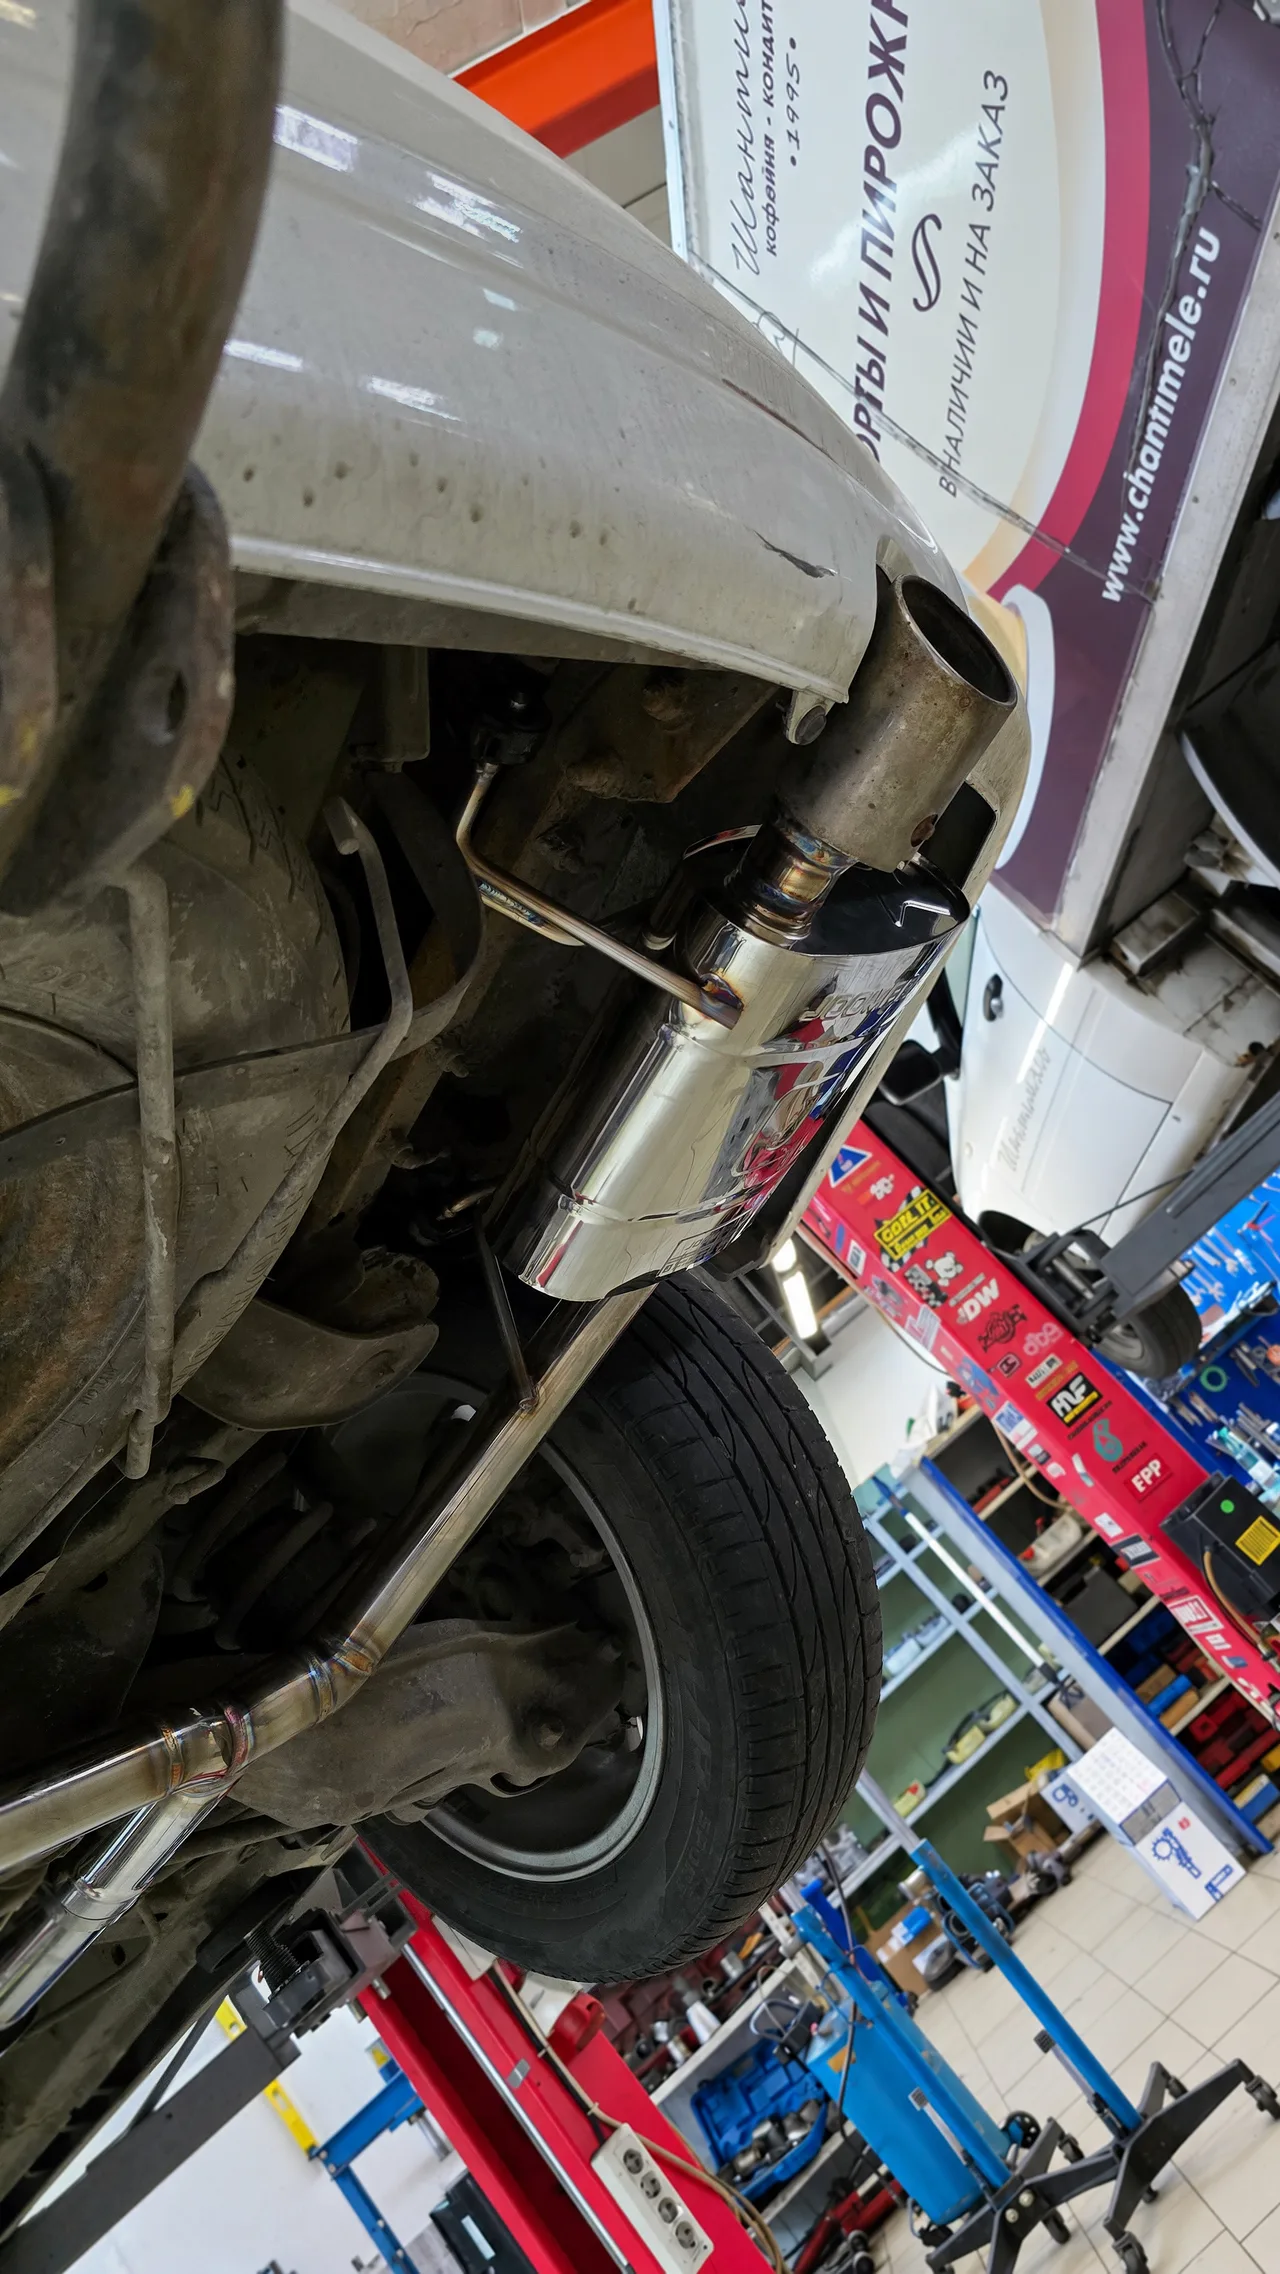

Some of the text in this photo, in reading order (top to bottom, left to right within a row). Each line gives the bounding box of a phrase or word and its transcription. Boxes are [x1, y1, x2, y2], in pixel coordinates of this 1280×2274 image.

[730, 0, 760, 275] Шанти
[858, 281, 890, 337] И
[939, 70, 1008, 498] В НАЛИЧИИ И НА ЗАКАЗ
[1102, 227, 1221, 602] www.chantimele.ru
[1131, 1459, 1161, 1493] EPP
